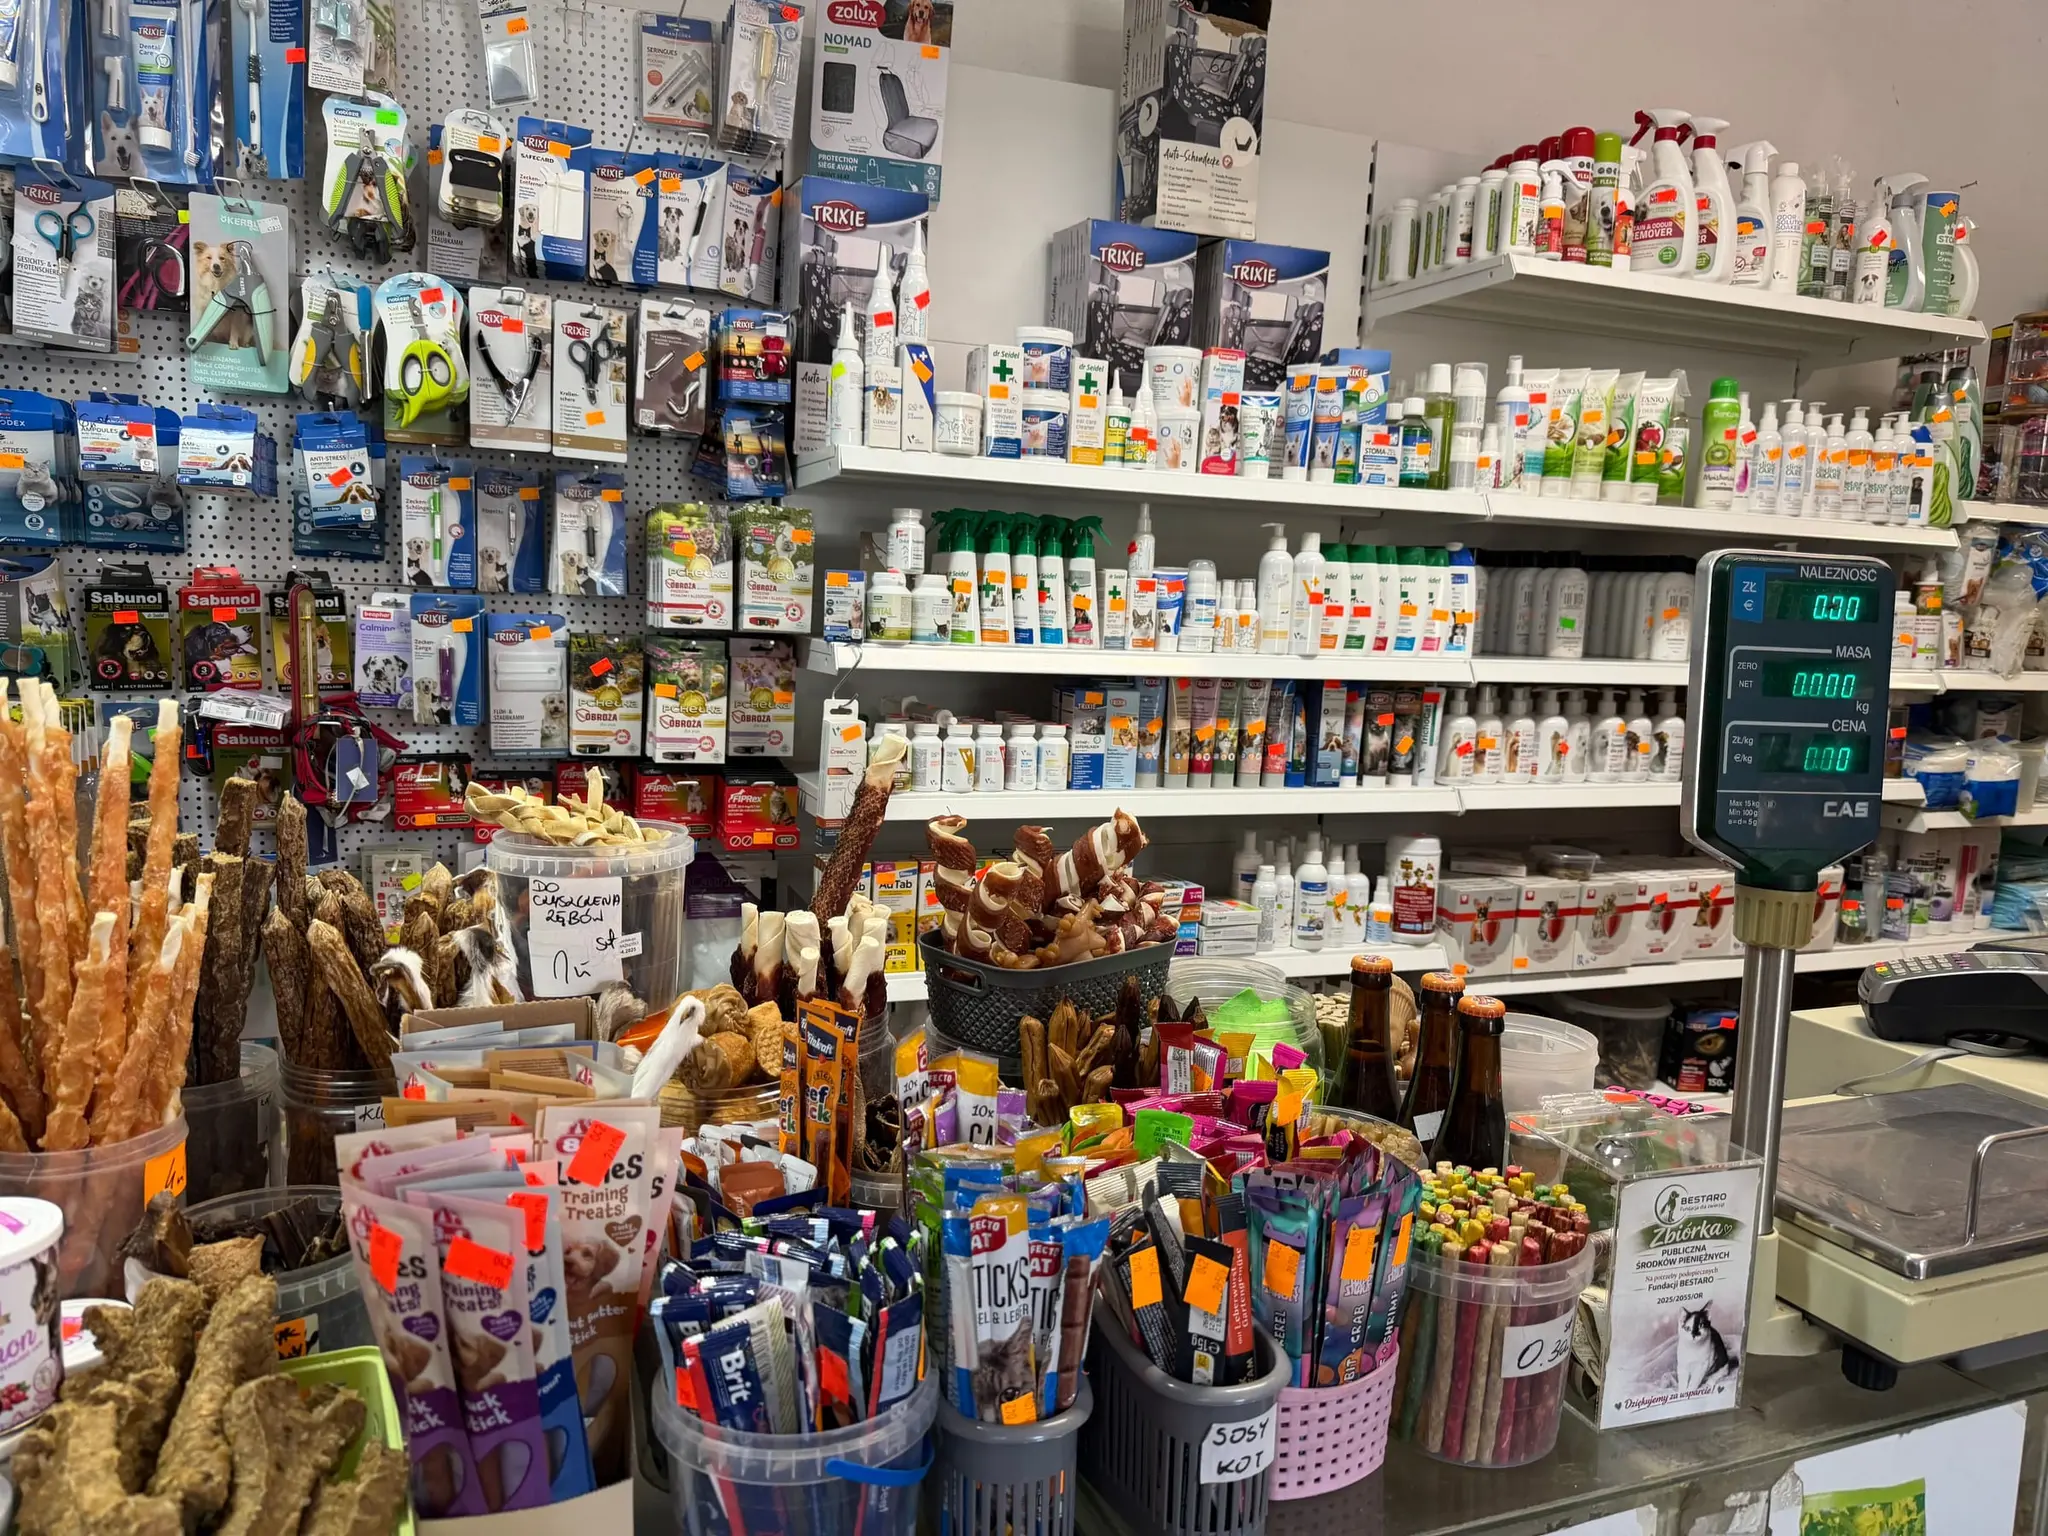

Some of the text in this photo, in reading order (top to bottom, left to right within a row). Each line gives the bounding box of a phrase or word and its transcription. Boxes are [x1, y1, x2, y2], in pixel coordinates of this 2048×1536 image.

[835, 3, 878, 22] zolux
[138, 26, 165, 38] TRIXIE
[824, 33, 872, 49] NOMAD
[646, 47, 678, 56] SERINGUES
[523, 136, 547, 150] TRIXI
[521, 153, 555, 164] SAFECARD
[818, 154, 859, 165] PROTECTION
[596, 167, 625, 180] TRIXIE
[836, 164, 858, 173] AVANT
[22, 185, 62, 203] TRIXIE
[732, 182, 752, 197] TRIXIE
[812, 202, 868, 229] TRIXIE
[1652, 221, 1673, 229] ODOUR
[1634, 228, 1673, 241] EMOVER
[1099, 244, 1146, 269] TRIXIE
[1232, 263, 1278, 286] TRIXIE
[562, 323, 591, 338] TRIXIE
[733, 319, 755, 332] TRIXIE
[1001, 350, 1020, 359] Seidel
[1086, 364, 1105, 372] Seidel
[407, 473, 440, 487] TRIXIE
[483, 483, 514, 496] TRIXIE
[563, 488, 593, 500] TRIXIE
[1742, 581, 1757, 593] ZŁ
[91, 591, 163, 604] Sabunol
[188, 593, 256, 607] Sabunol
[91, 603, 122, 611] PLUS
[363, 610, 391, 619] beaphar
[416, 614, 448, 625] TRIXIE
[493, 632, 525, 643] TRIXIE
[1835, 645, 1872, 659] MASA
[1736, 661, 1758, 670] ZERO
[1738, 680, 1754, 688] NET
[1792, 672, 1856, 698] 0.000
[1855, 700, 1870, 714] kg
[1831, 719, 1868, 732] CENA
[218, 732, 285, 745] Sabunol
[1731, 735, 1754, 747] ZŁ/kg
[1733, 753, 1753, 764] €/kg
[1804, 746, 1851, 771] 0.00
[1728, 799, 1743, 807] Max
[1823, 801, 1869, 818] CAS
[1728, 808, 1741, 816] Min
[532, 879, 560, 894] DO
[972, 1104, 995, 1119] 10x
[562, 1186, 629, 1206] Training
[1680, 1193, 1728, 1206] BESTARO
[565, 1203, 627, 1222] Treats!
[970, 1233, 992, 1250] AT
[1650, 1221, 1724, 1248] Zbiórka
[1661, 1244, 1707, 1257] PUBLICZNA
[1635, 1250, 1730, 1270] ŚRODKÓW PIENIĘŻNYCH
[1644, 1265, 1719, 1284] Na potrzeby podopiecznych
[973, 1256, 1029, 1310] TICKS
[1236, 1247, 1248, 1328] Gartengemüse
[1647, 1275, 1714, 1292] Fundacji BESTARO
[1231, 1267, 1242, 1331] Leberwurst
[1656, 1291, 1704, 1305] 2025/2055/OR
[1003, 1305, 1030, 1325] LEBER
[1383, 1290, 1399, 1344] SHRIMP
[1350, 1303, 1366, 1344] CRAB
[719, 1349, 753, 1406] Brit
[1623, 1385, 1717, 1411] Dziękujemy za wsparcie!
[1211, 1416, 1270, 1446] SOSY
[1216, 1451, 1264, 1476] KOT
